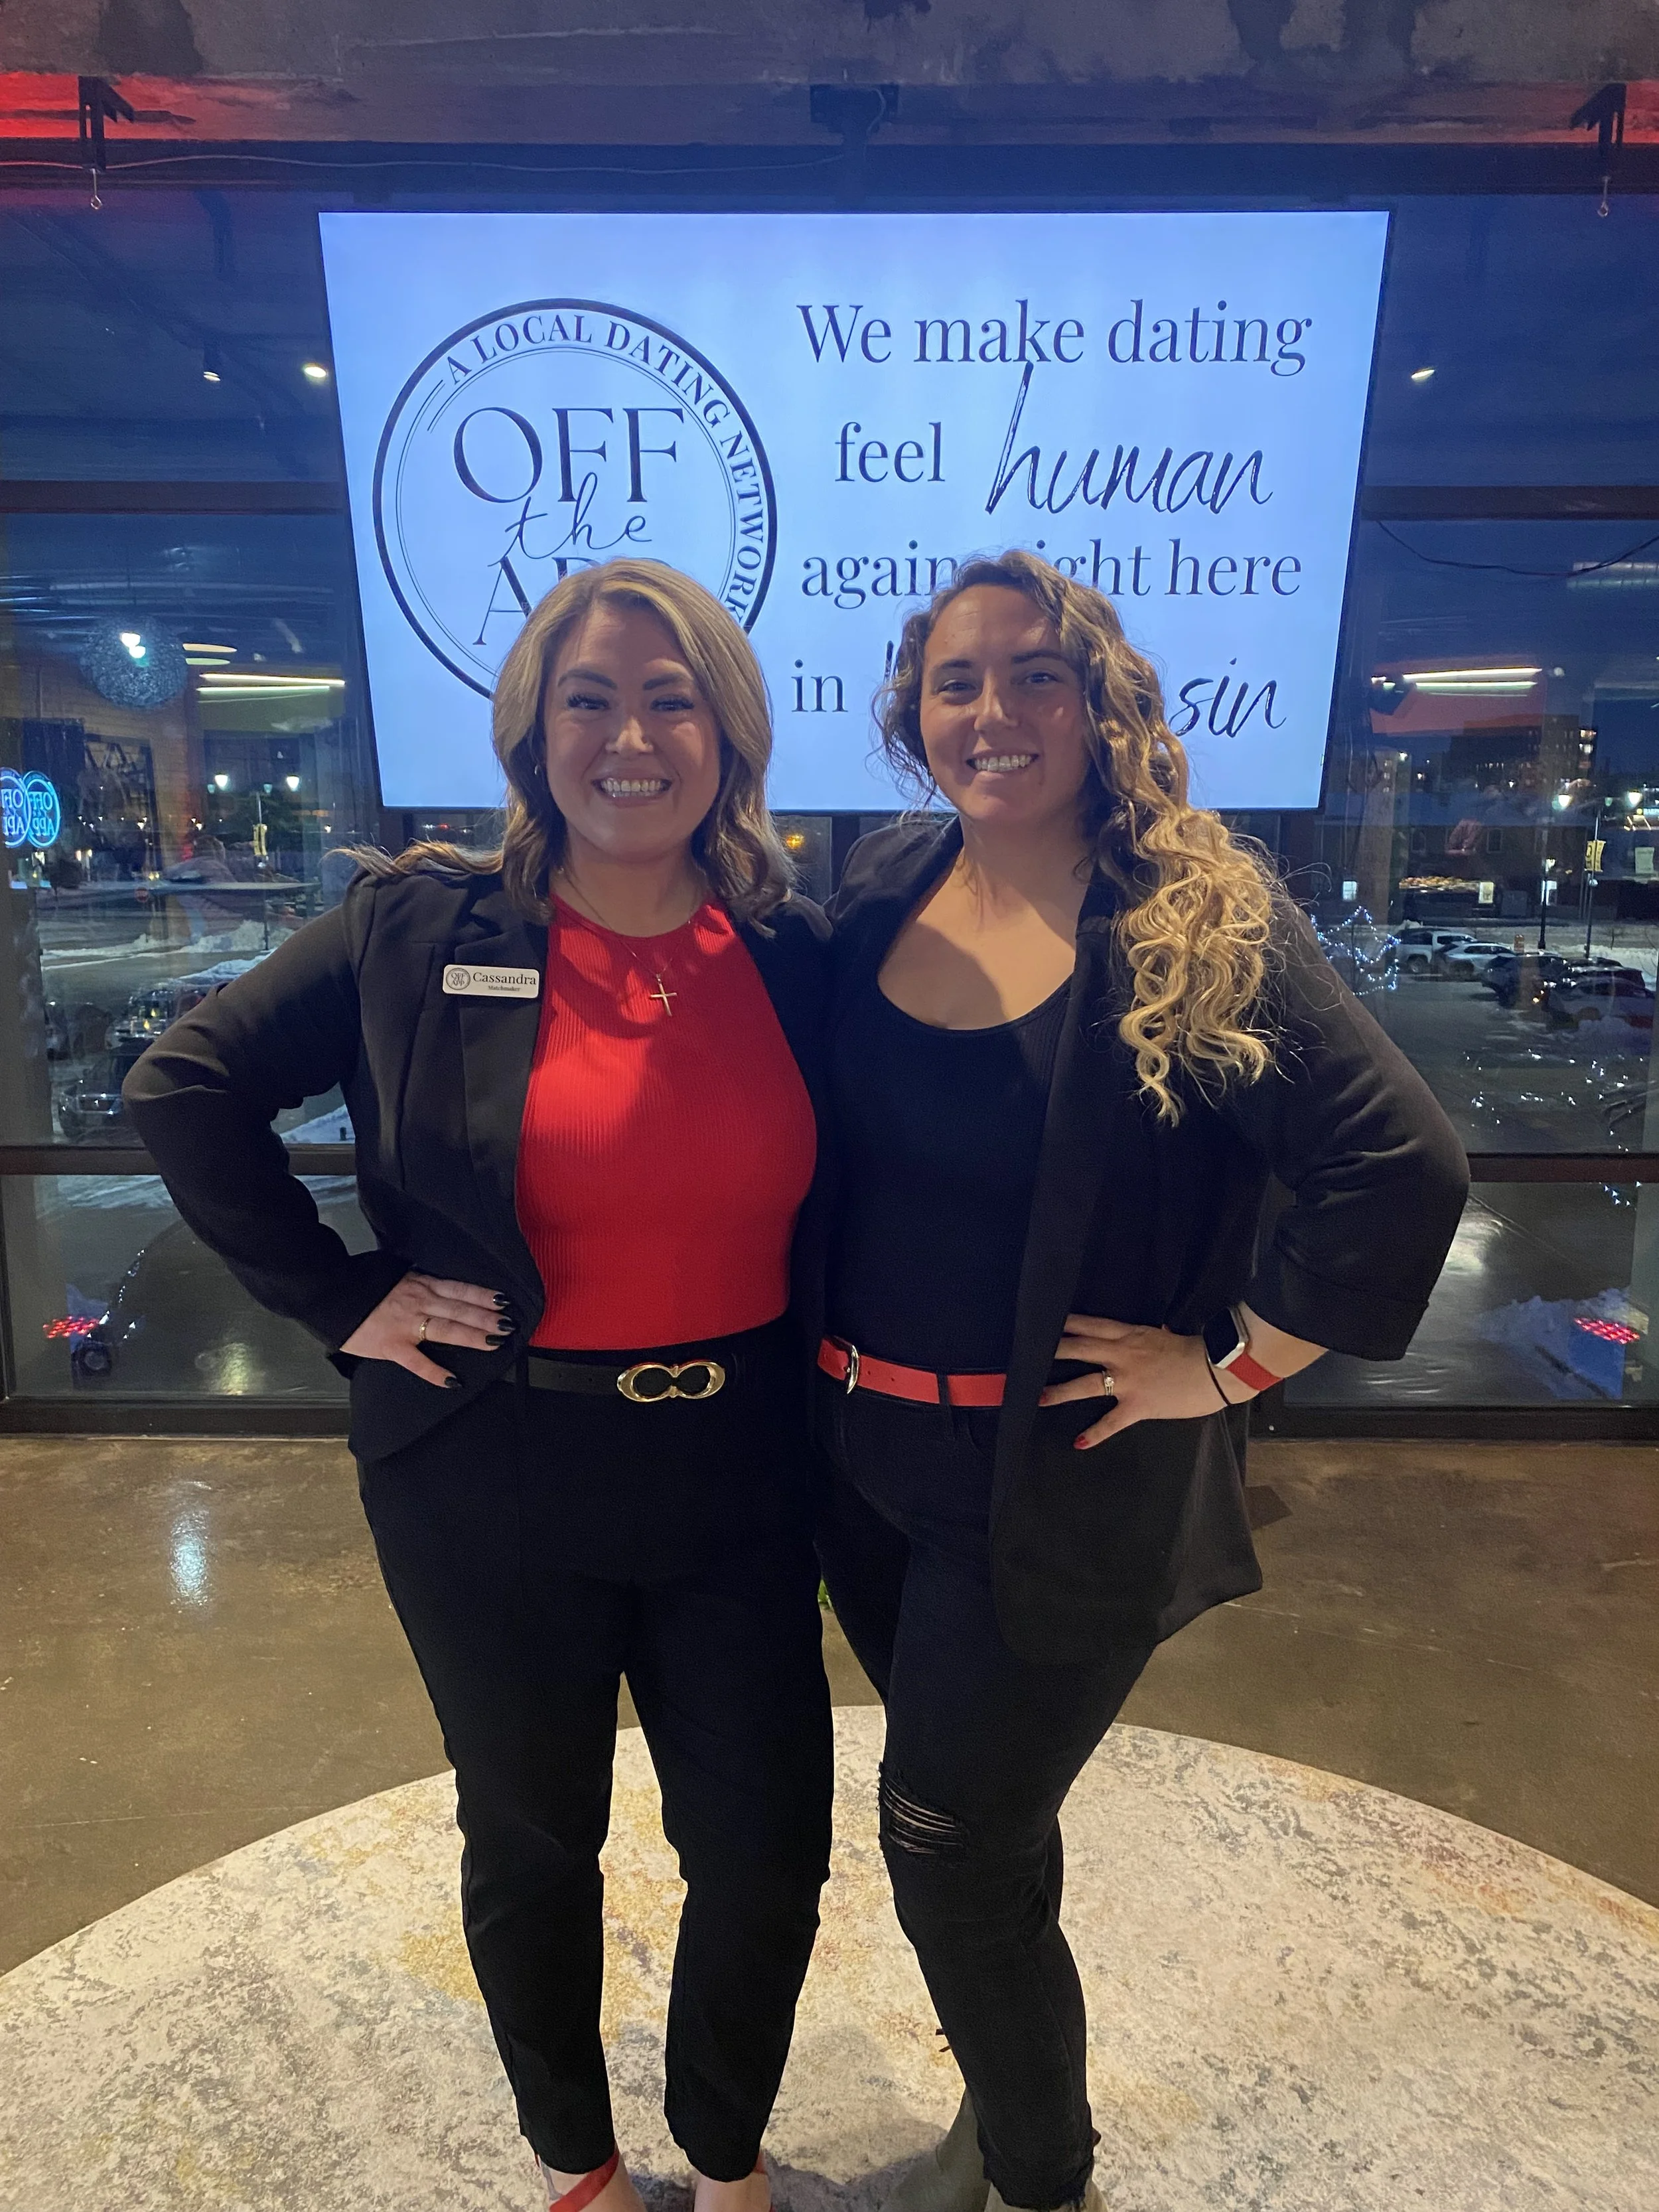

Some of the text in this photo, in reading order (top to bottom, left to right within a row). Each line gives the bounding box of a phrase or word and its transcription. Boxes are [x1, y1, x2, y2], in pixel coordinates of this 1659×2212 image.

[797, 299, 1313, 377] We make dating
[447, 356, 472, 385] A
[470, 315, 593, 364] LOCAL
[605, 321, 731, 429] DATING
[719, 430, 766, 624] NETWORK
[453, 407, 685, 504] OFF
[833, 361, 1273, 515] feel human
[488, 471, 653, 567] the
[1165, 539, 1303, 596] here
[791, 659, 848, 714] in
[473, 972, 536, 985] Cassandra
